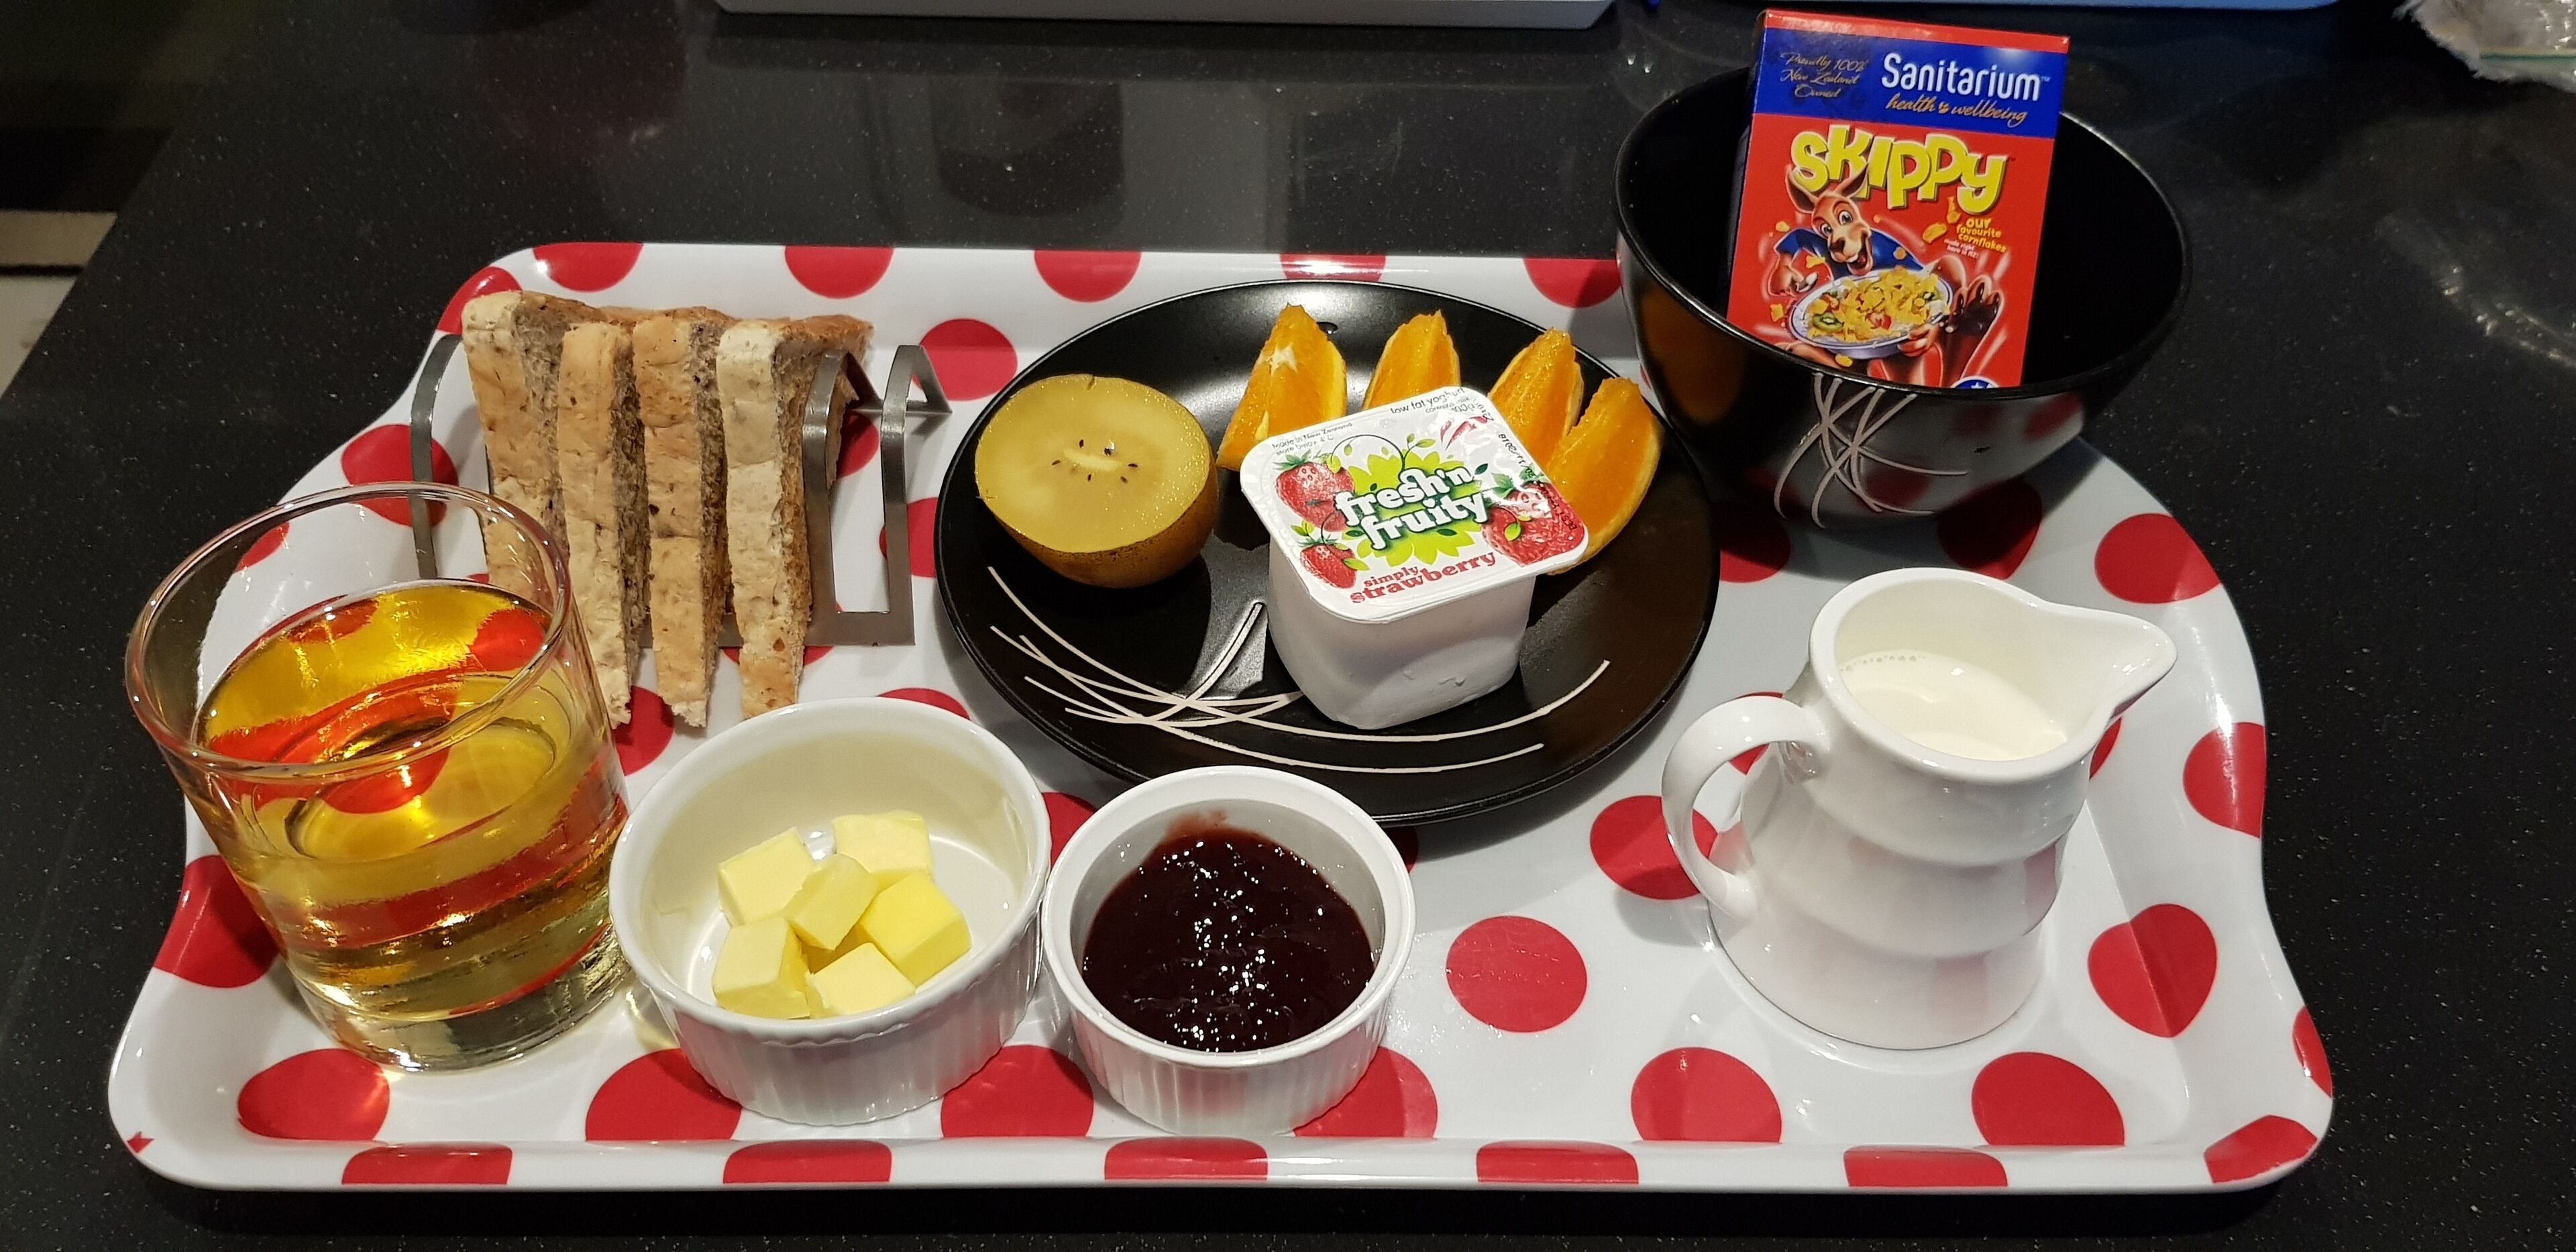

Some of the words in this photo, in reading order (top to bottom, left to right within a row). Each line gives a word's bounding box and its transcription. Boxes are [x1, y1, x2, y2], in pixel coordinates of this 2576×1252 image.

[1780, 52, 1831, 71] Proudly
[1833, 58, 1869, 72] 100%
[1780, 68, 1809, 82] New
[1810, 72, 1860, 85] Zealand
[1881, 52, 2041, 101] Sanitarium
[1794, 84, 1841, 97] Owned
[1885, 92, 1937, 113] health
[1951, 99, 2028, 127] wellbeing
[1956, 223, 2002, 238] favourite
[1966, 218, 1992, 228] our
[1958, 233, 2007, 253] cornflakes
[1390, 405, 1409, 413] low
[1411, 399, 1426, 409] fat
[1426, 386, 1466, 406] yoghurt
[1360, 492, 1489, 550] fruity
[1350, 552, 1496, 603] strawberry
[1363, 566, 1419, 587] simply
